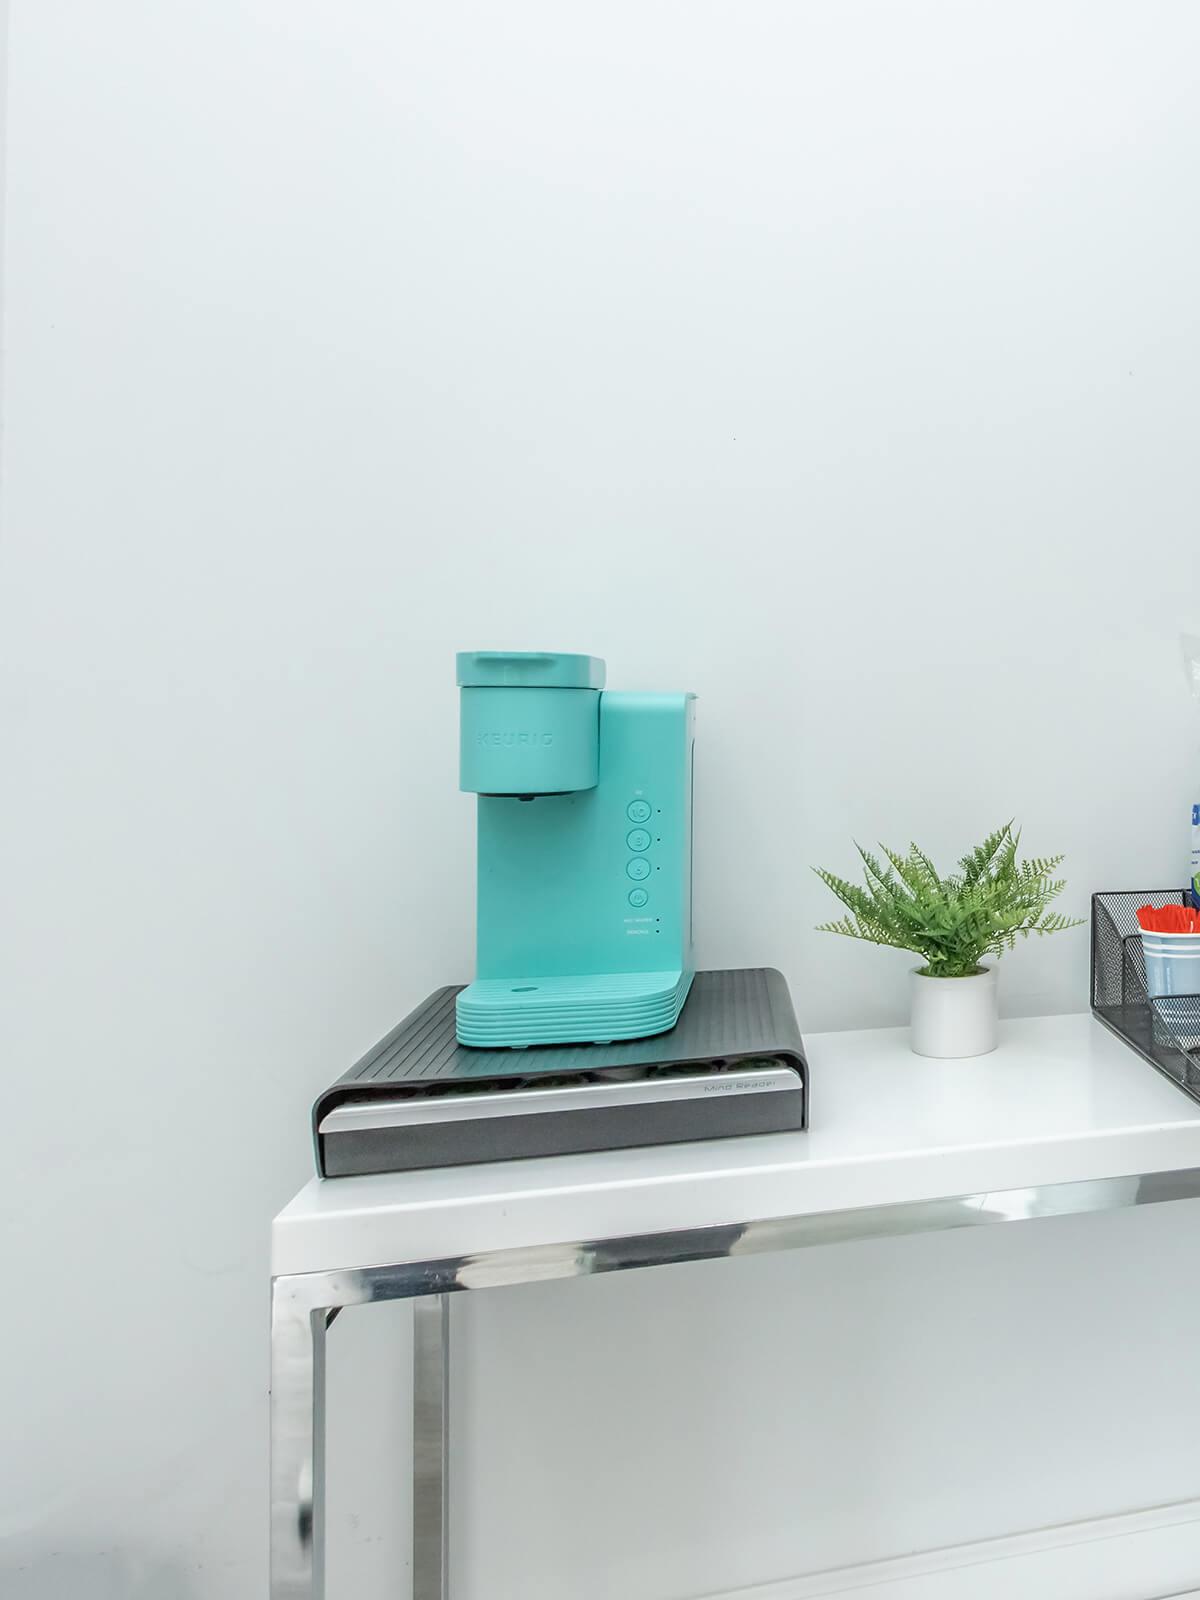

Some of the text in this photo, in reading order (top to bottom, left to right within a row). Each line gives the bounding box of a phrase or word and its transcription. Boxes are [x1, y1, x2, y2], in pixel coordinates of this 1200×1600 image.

[475, 732, 553, 747] KEURIG
[704, 1080, 776, 1093] Mind Reader
